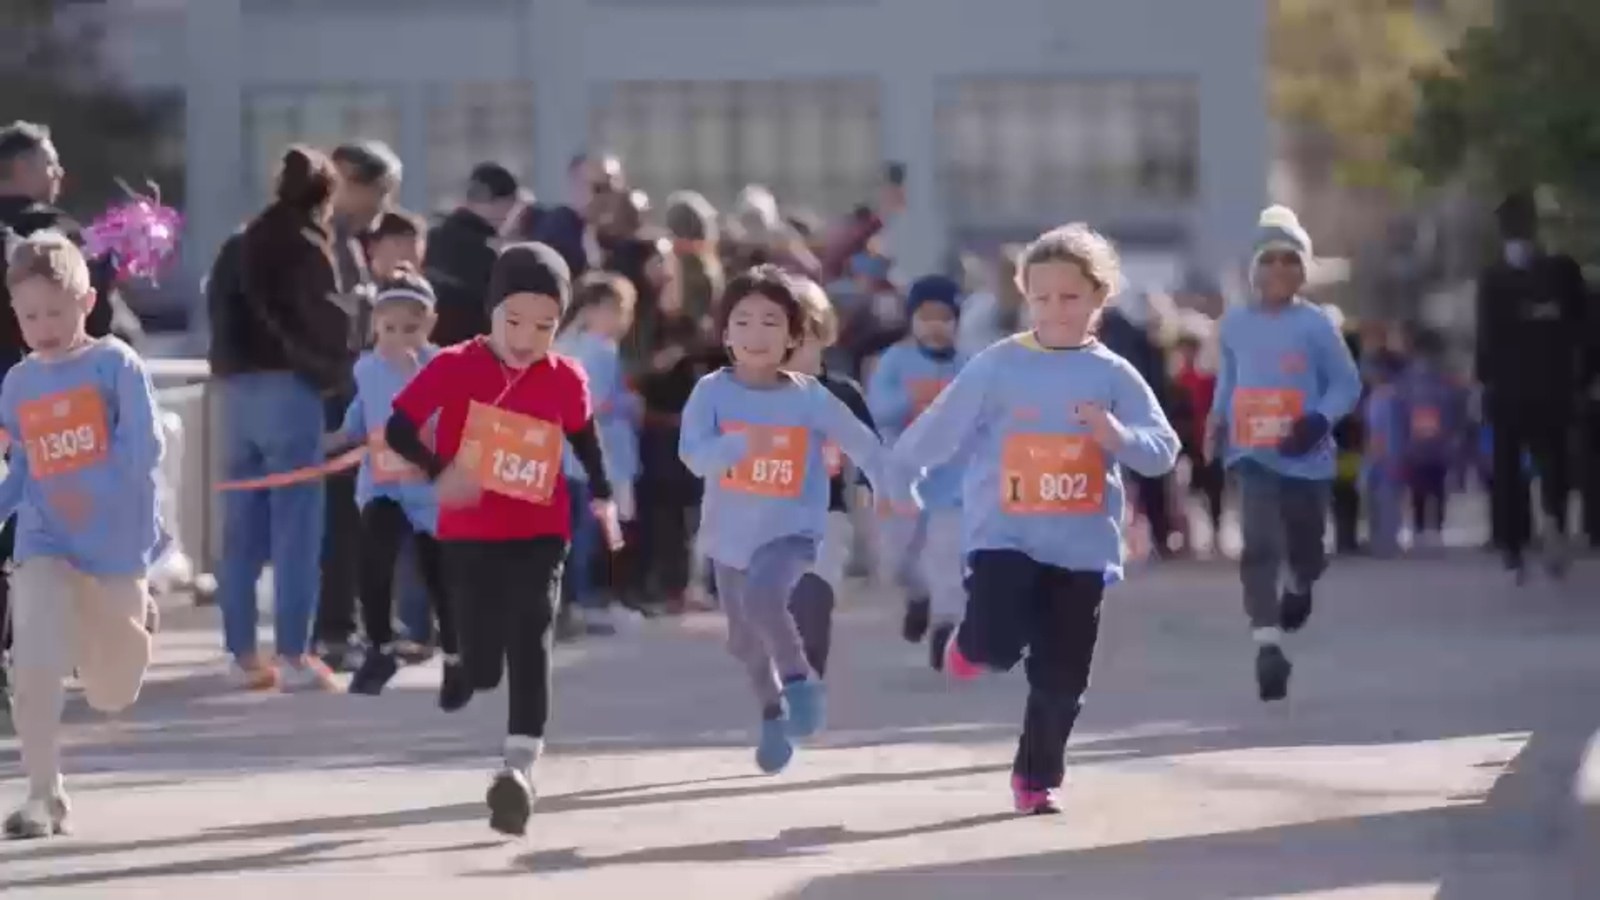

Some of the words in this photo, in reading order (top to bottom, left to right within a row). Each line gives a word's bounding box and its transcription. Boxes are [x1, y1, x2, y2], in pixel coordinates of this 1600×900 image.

[39, 424, 94, 461] 1309
[492, 448, 548, 488] 1341
[1039, 472, 1088, 500] 802
